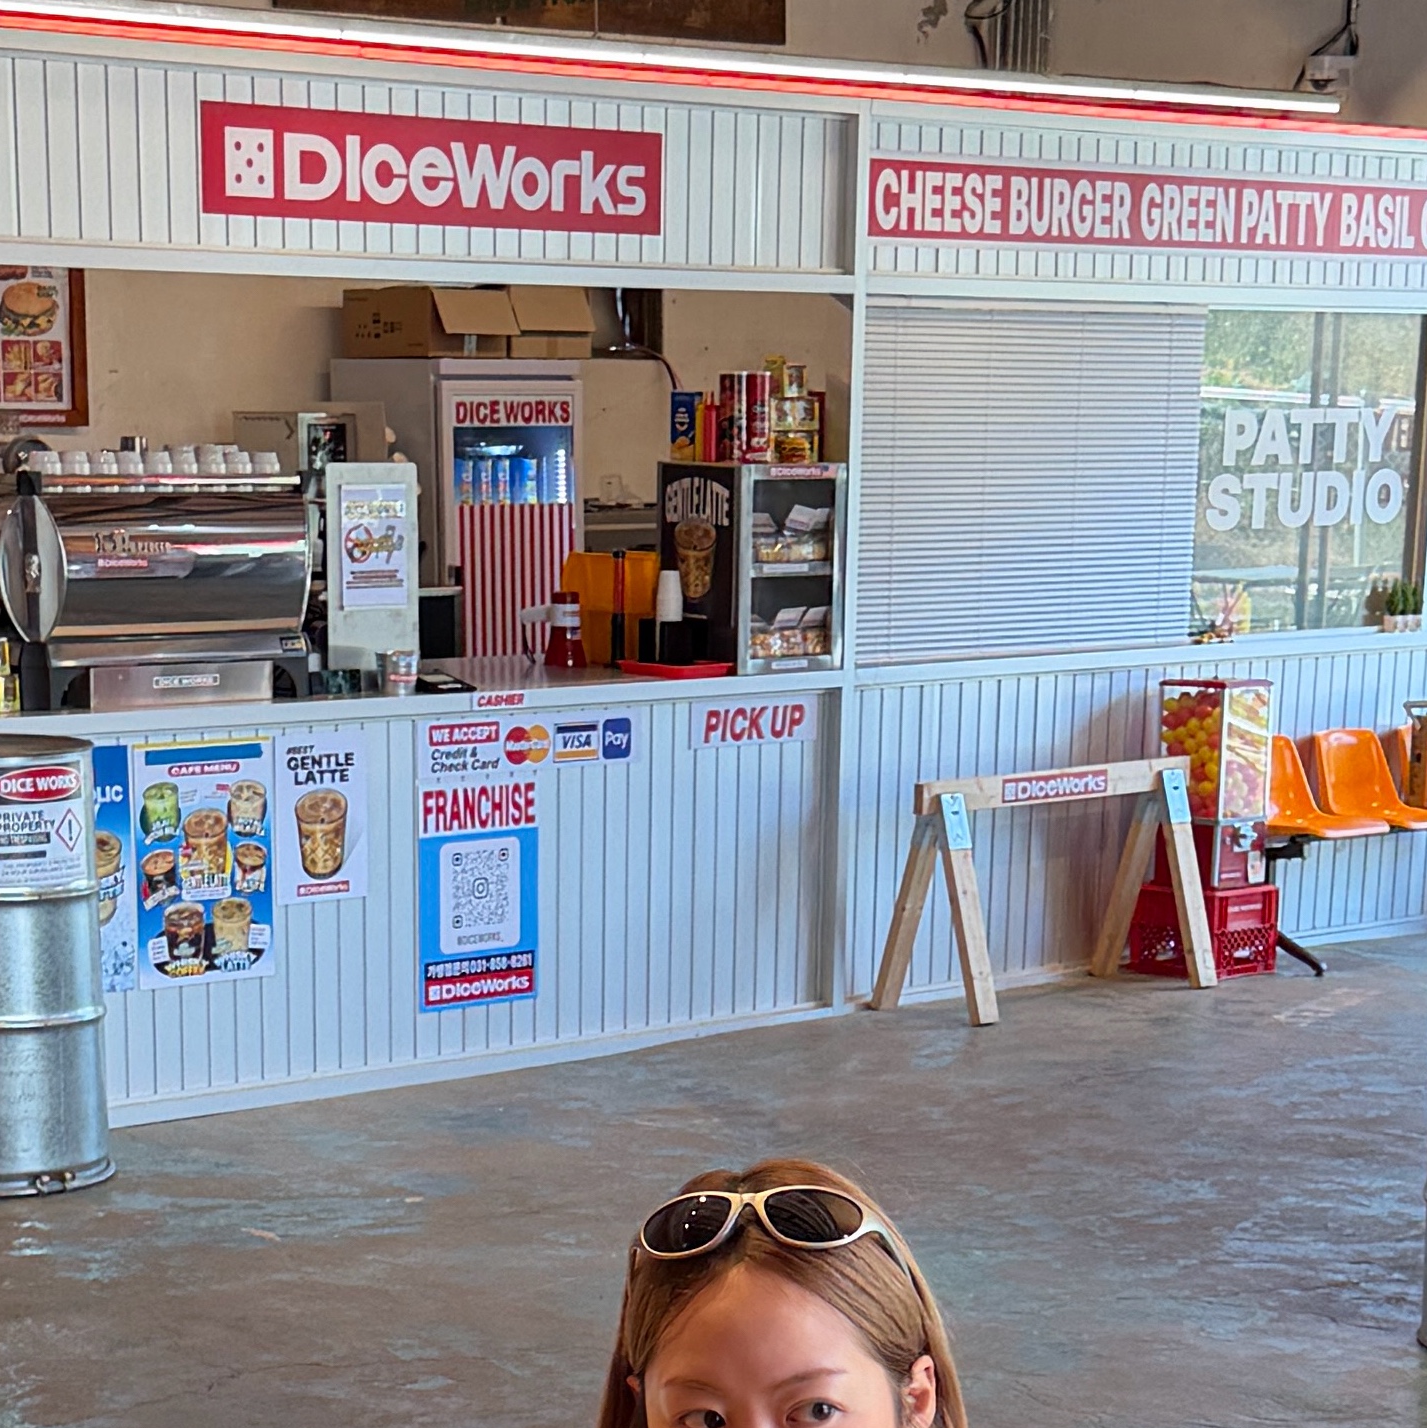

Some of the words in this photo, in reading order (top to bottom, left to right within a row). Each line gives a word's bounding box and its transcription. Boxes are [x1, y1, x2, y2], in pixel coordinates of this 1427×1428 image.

[283, 132, 646, 217] DiceWorks
[875, 169, 1003, 235] CHEESE
[1009, 176, 1132, 239] BURGER
[1141, 183, 1235, 243] GREEN
[1240, 188, 1330, 246] PATTY
[1340, 193, 1415, 250] BASIL
[456, 401, 500, 424] DICE
[505, 401, 570, 424] WORKS
[1223, 407, 1397, 466] PATTY
[1206, 468, 1402, 531] STUDIO
[478, 693, 524, 707] CASHIER
[703, 706, 768, 743] PICK
[770, 703, 805, 738] UP
[432, 728, 450, 742] WE
[453, 725, 498, 741] ACCEPT
[562, 734, 592, 750] VISA
[605, 731, 628, 749] Pay
[287, 752, 355, 771] GENTLE
[431, 748, 466, 761] Credit
[171, 765, 202, 776] CAFE
[204, 762, 237, 774] MENU
[431, 760, 469, 774] Check
[471, 758, 500, 772] Card
[0, 778, 35, 794] DICE
[36, 774, 77, 791] WORKS
[294, 768, 350, 786] LATTE
[1018, 775, 1106, 800] DiceWorks
[423, 782, 535, 834] FRANCHISE
[442, 976, 530, 999] DiceWorks
